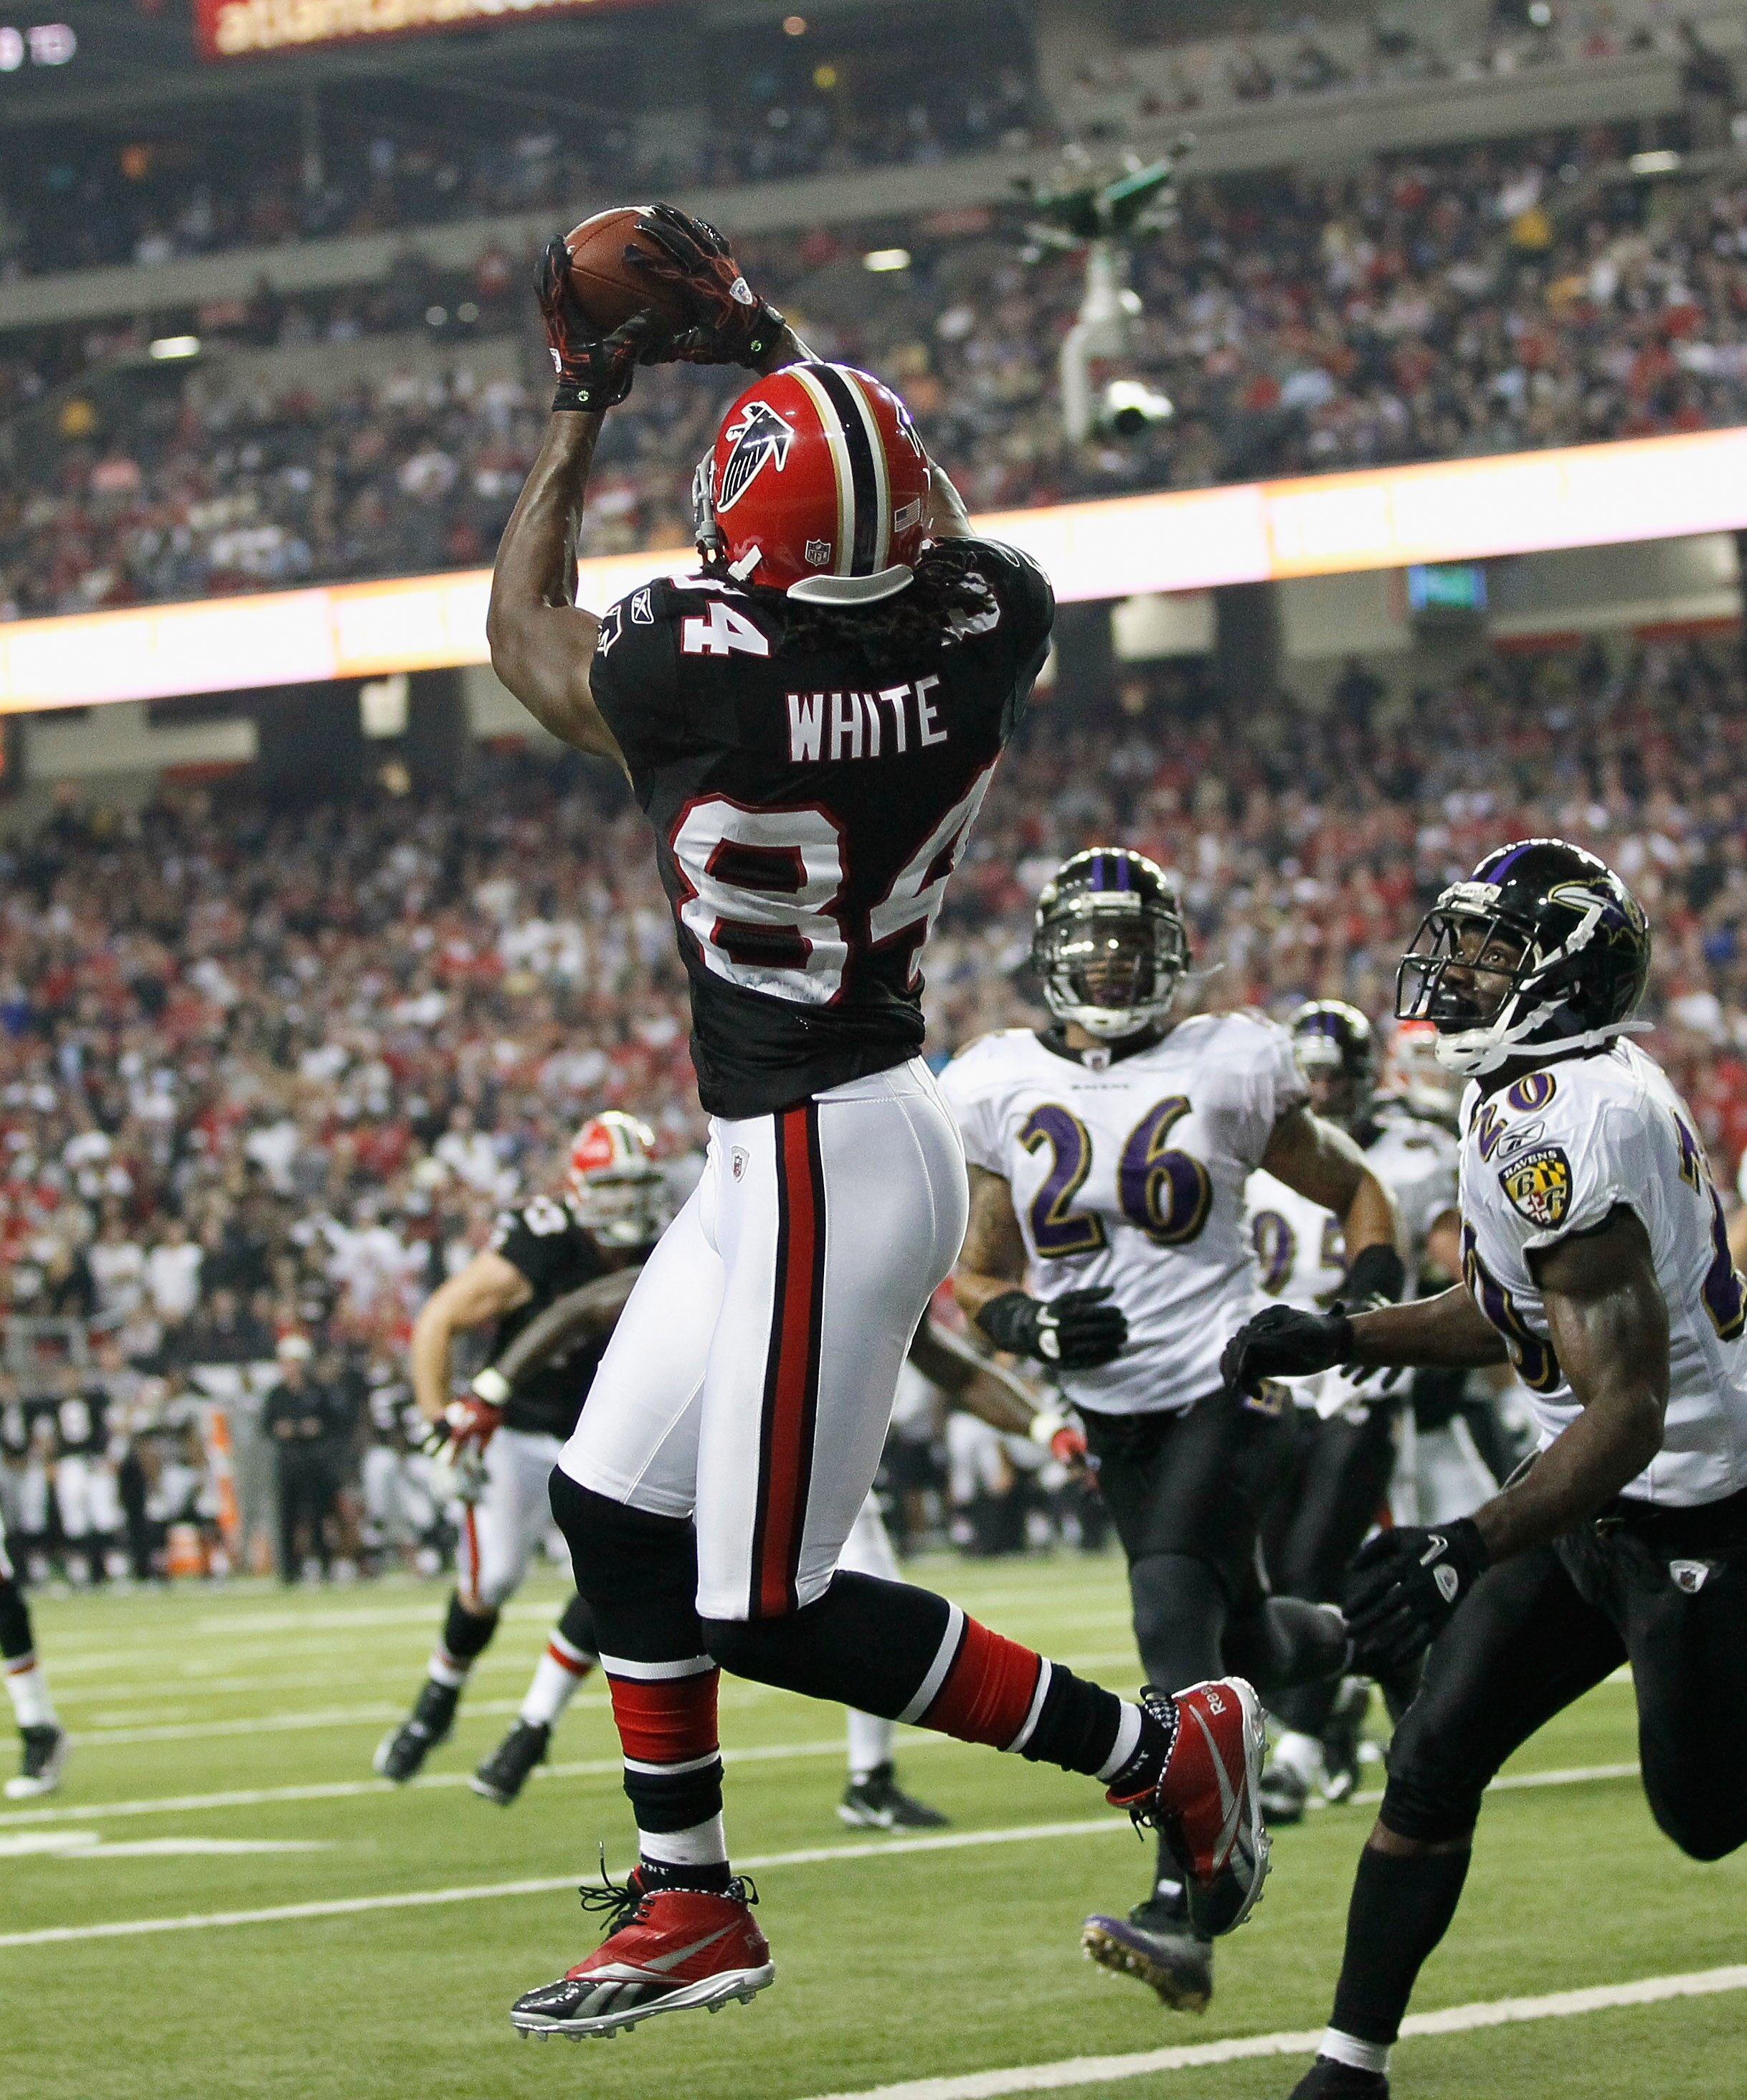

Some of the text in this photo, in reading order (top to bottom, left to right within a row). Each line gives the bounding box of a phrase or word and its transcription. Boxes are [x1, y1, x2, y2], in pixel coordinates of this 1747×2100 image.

[786, 673, 947, 762] WHITE
[671, 755, 998, 1006] 84
[1016, 1094, 1213, 1259] 26
[1470, 1071, 1556, 1163] 20
